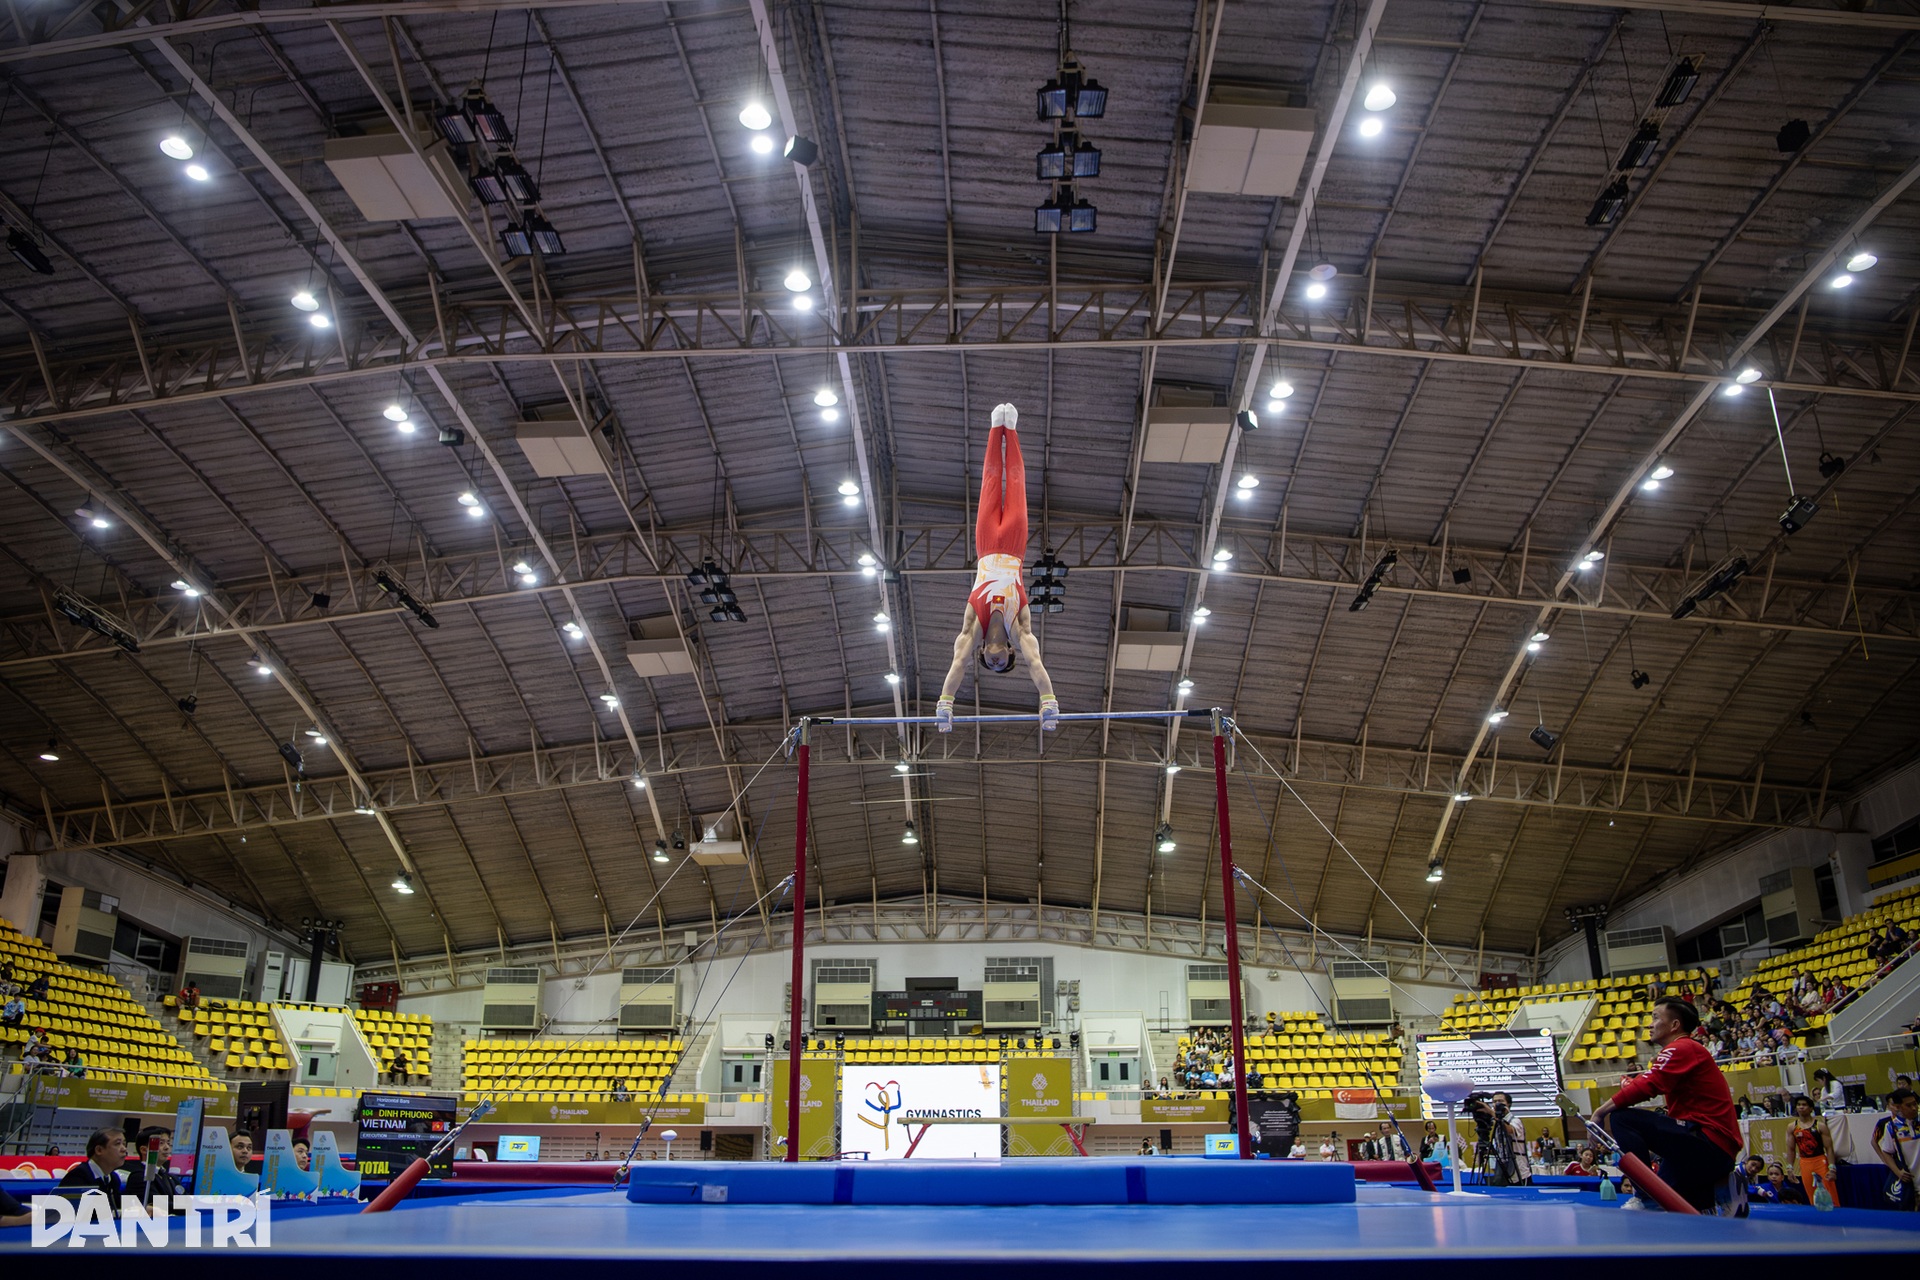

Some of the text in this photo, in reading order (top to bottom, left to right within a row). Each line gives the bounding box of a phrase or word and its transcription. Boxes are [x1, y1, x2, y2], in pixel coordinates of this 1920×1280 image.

[1021, 1099, 1060, 1107] THAILAND
[378, 1109, 399, 1117] DINH
[399, 1110, 433, 1119] PHUONG
[906, 1109, 982, 1118] GYMNASTICS
[362, 1118, 407, 1129] VIETNAM
[359, 1161, 390, 1175] TOTAL
